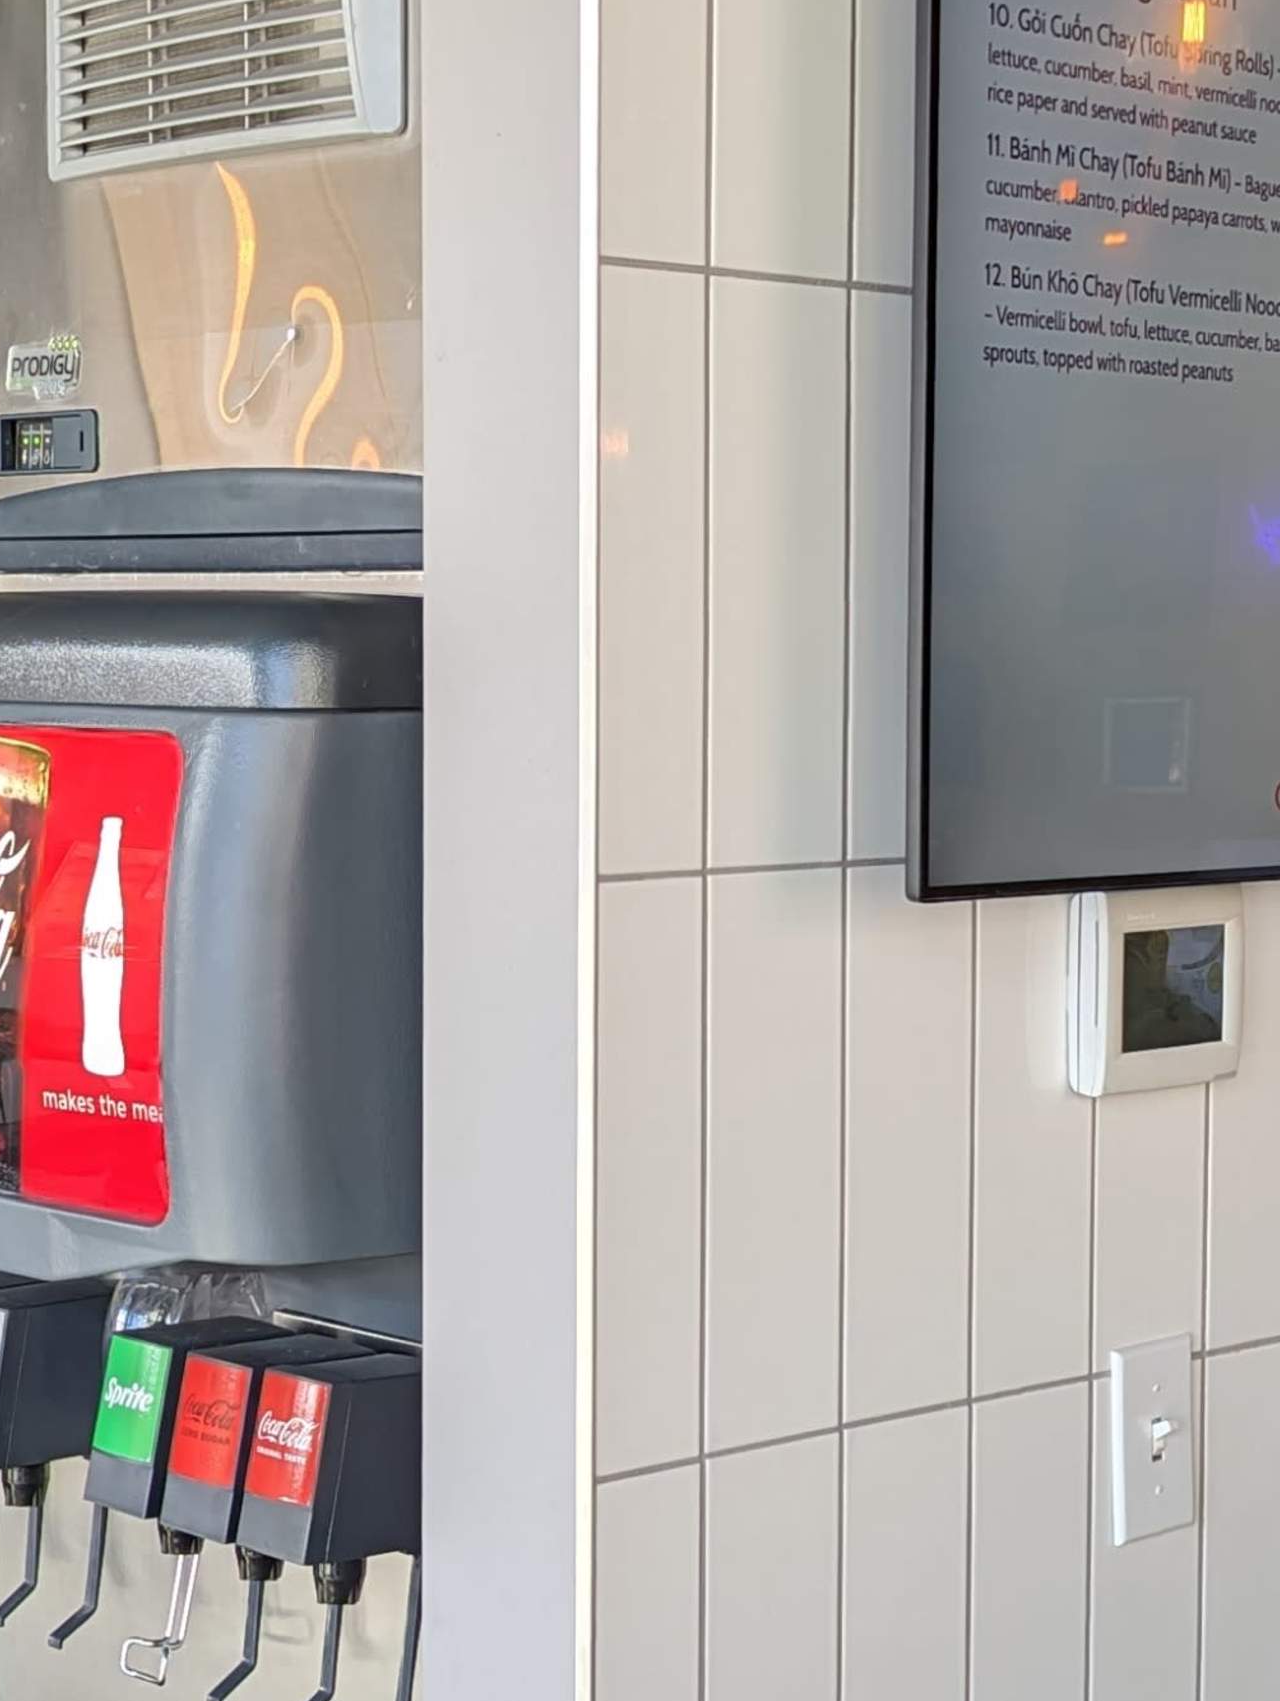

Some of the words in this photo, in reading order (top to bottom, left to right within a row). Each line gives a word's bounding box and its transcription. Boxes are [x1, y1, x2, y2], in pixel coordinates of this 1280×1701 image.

[986, 80, 1014, 106] rice
[1016, 90, 1059, 113] paper
[1059, 95, 1089, 117] and
[1090, 102, 1137, 126] served
[1138, 107, 1169, 130] with
[1170, 116, 1219, 139] peanut
[1219, 124, 1257, 145] sauce
[984, 262, 1006, 288] 12.
[1010, 264, 1043, 291] Bún
[1046, 268, 1079, 296] Khô
[1081, 272, 1123, 304] Chay
[1125, 277, 1165, 305] (Tofu
[1167, 283, 1243, 313] Vermicelli
[42, 1089, 95, 1115] makes
[99, 1094, 127, 1118] the
[104, 1376, 154, 1412] Sprite
[257, 1410, 319, 1450] Coca-Cola
